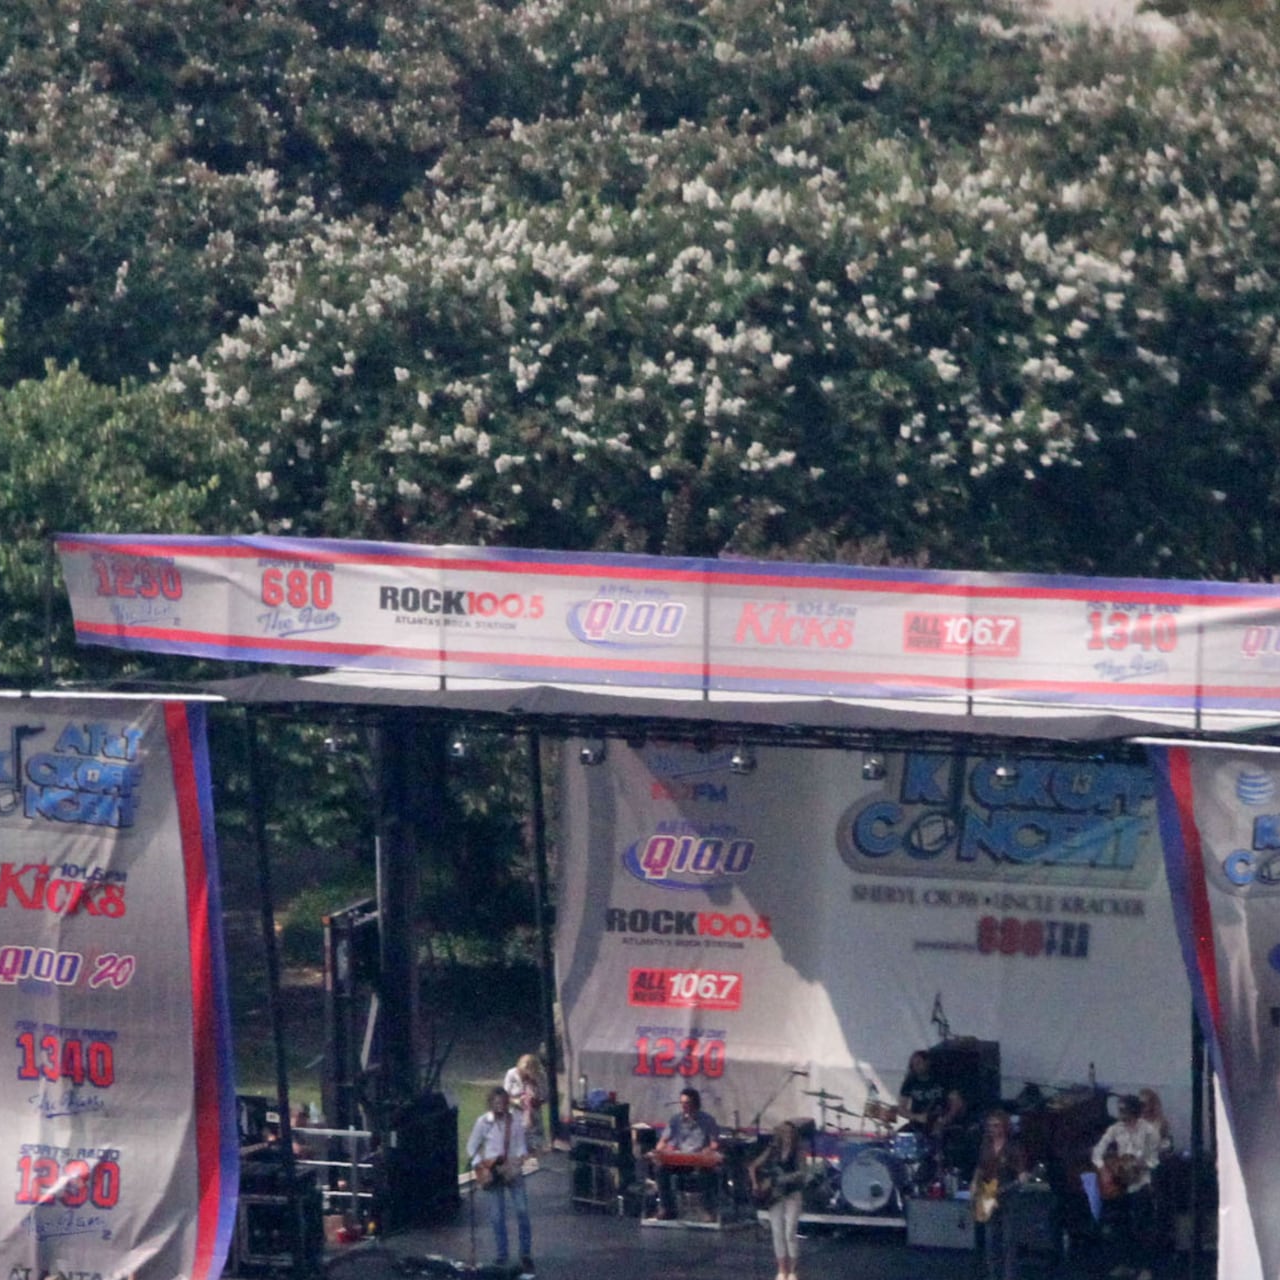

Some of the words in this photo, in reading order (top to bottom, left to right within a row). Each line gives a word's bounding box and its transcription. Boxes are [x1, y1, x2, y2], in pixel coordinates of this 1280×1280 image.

[93, 559, 183, 600] 1230
[261, 567, 333, 610] 680
[583, 599, 687, 641] Q100
[907, 616, 941, 635] ALL
[943, 616, 1014, 646] 106.7
[1087, 611, 1177, 653] 1340
[642, 835, 757, 879] Q100
[89, 952, 136, 989] 20
[633, 972, 665, 989] ALL
[669, 972, 740, 1001] 106.7
[16, 1032, 115, 1089] 1340
[633, 1036, 725, 1079] 1230
[21, 1143, 71, 1159] SPORTS
[77, 1148, 119, 1161] RADIO
[14, 1154, 120, 1210] 1230
